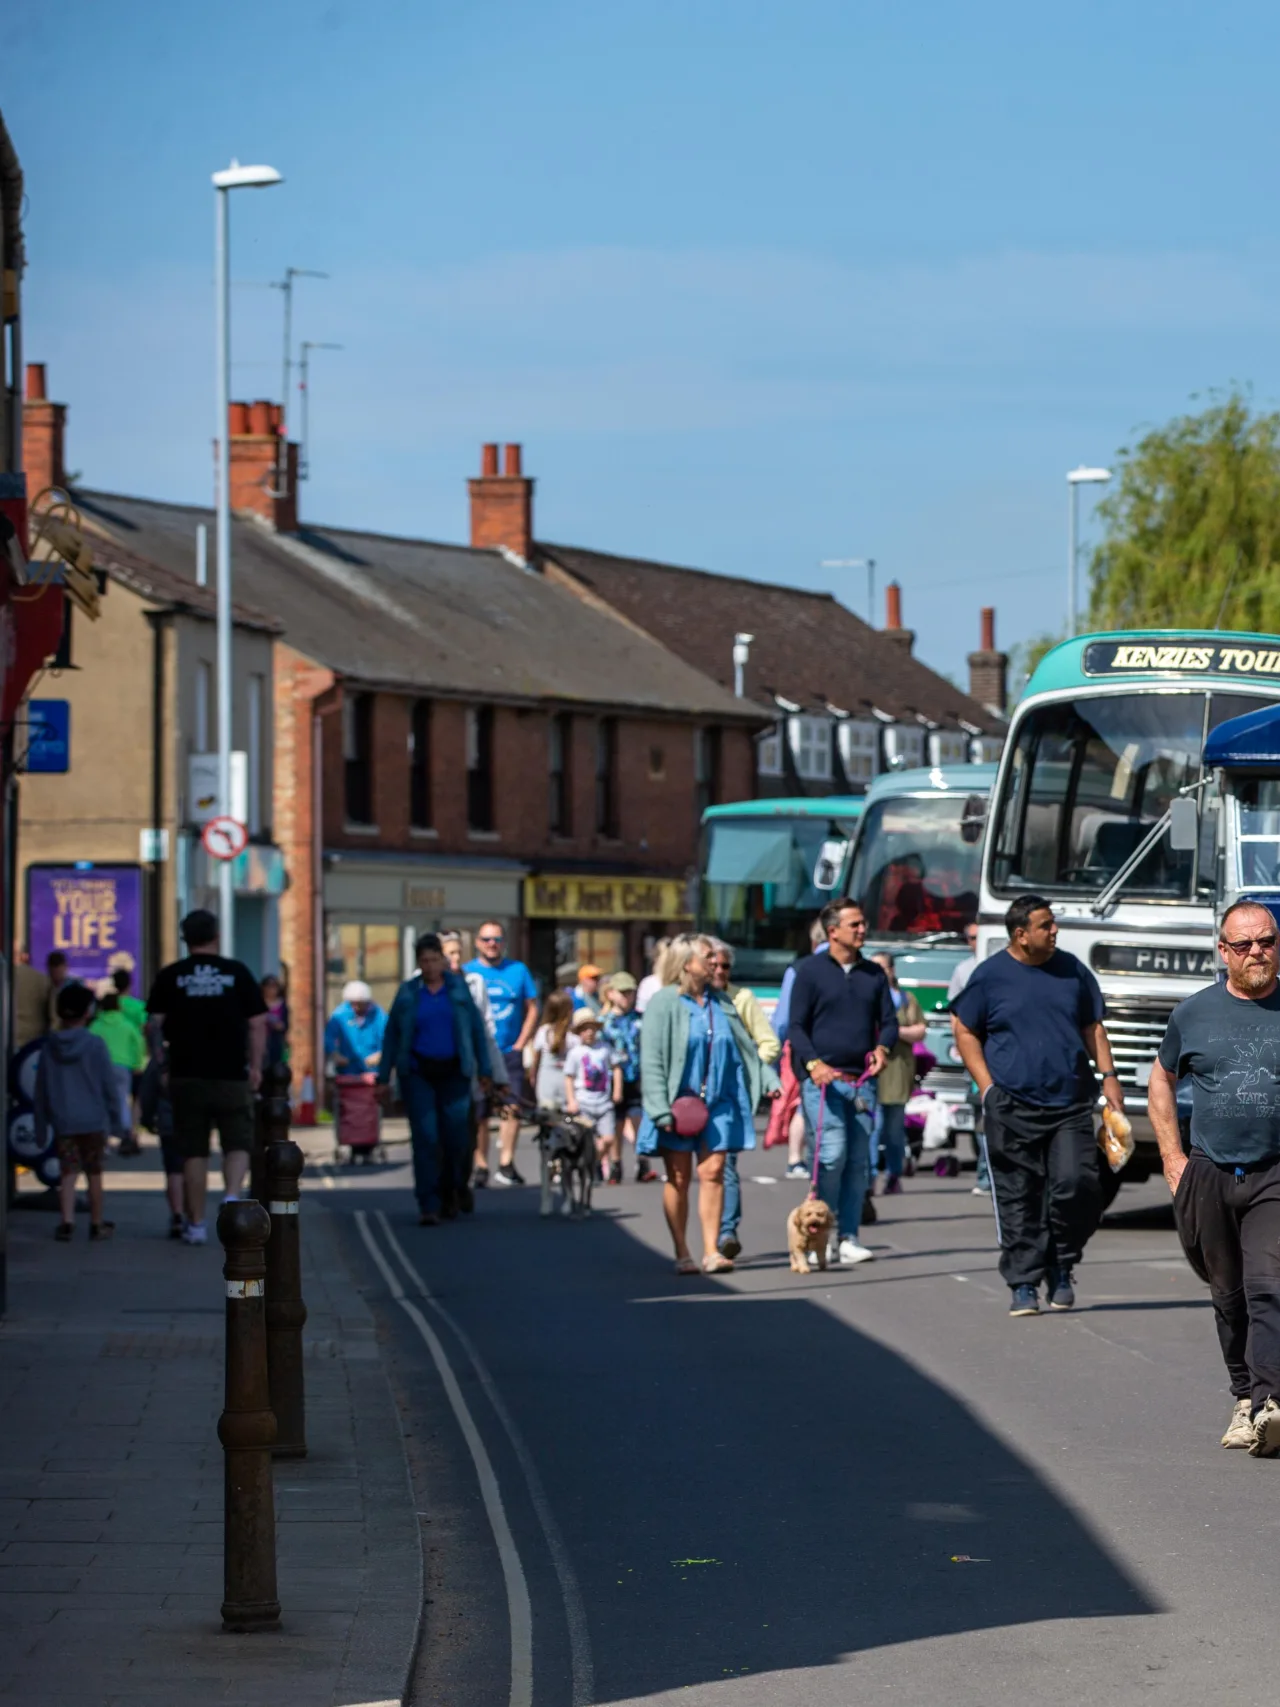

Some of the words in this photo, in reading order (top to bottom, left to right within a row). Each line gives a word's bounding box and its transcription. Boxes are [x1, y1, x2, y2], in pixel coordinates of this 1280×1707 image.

[1111, 646, 1215, 669] KENZIES
[54, 889, 117, 915] YOUR
[53, 914, 121, 949] LIFE
[1236, 1091, 1268, 1105] STATES
